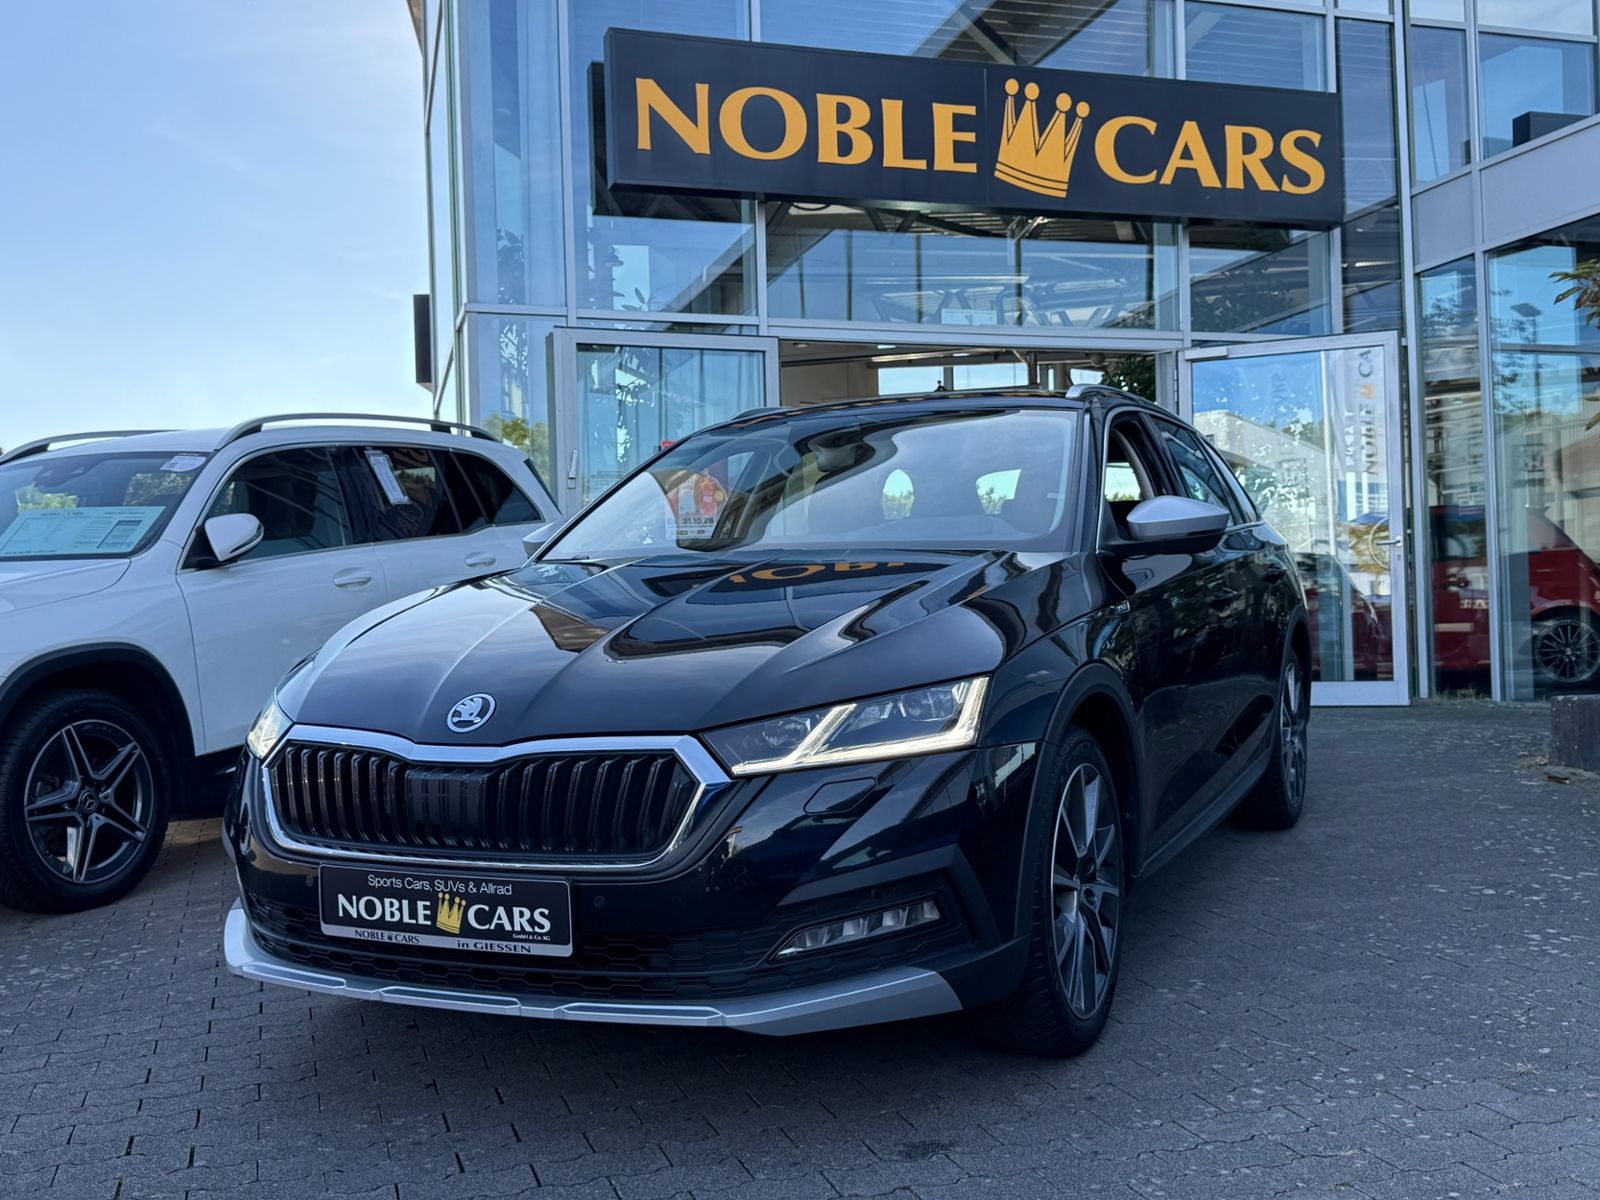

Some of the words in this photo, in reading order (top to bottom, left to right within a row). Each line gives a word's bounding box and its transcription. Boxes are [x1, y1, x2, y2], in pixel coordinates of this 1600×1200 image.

[635, 77, 978, 174] NOBLE
[1094, 115, 1326, 195] CARS
[368, 874, 403, 889] Sports
[404, 877, 433, 892] Cars,
[434, 879, 466, 893] SUVs
[468, 881, 477, 893] &
[480, 882, 512, 895] Allrad
[337, 893, 432, 926] NOBLE
[467, 904, 551, 933] CARS
[354, 929, 386, 940] NOBLE
[394, 933, 420, 944] CARS
[457, 940, 469, 948] in
[473, 941, 531, 953] GIESSEN
